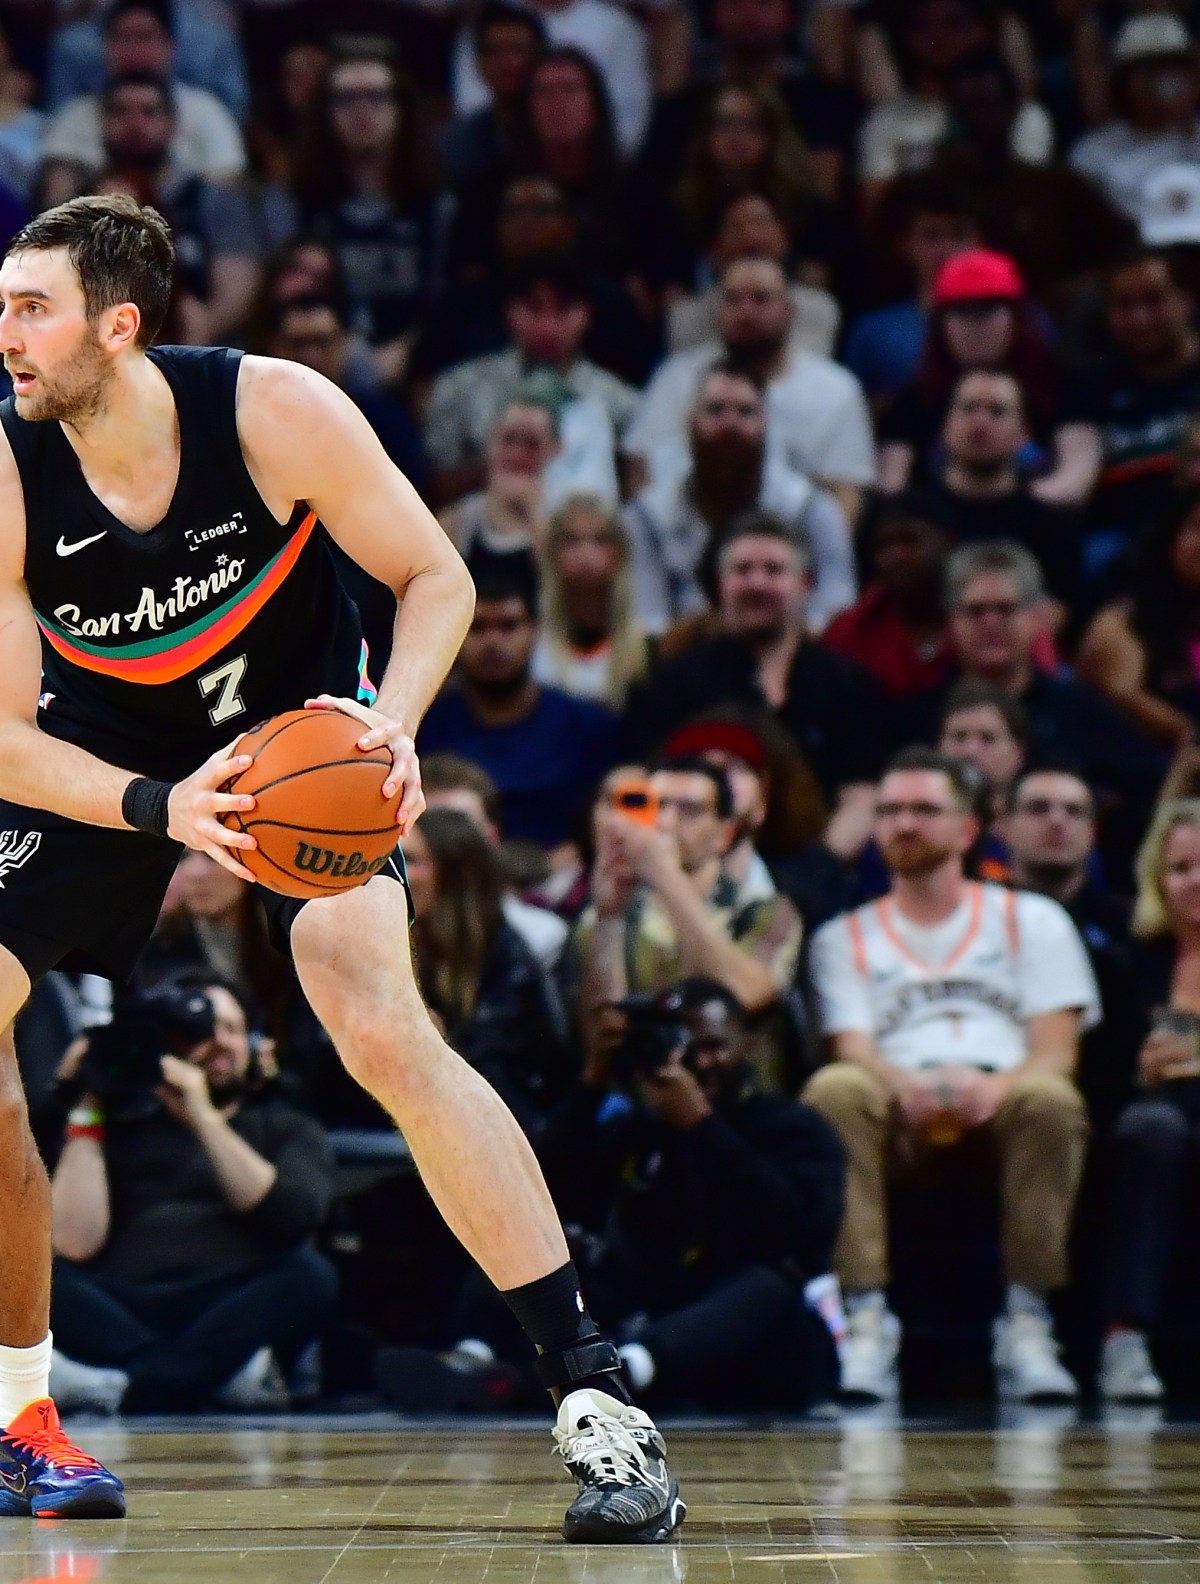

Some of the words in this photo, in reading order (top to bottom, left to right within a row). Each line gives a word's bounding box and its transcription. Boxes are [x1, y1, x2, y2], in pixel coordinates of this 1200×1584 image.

[193, 521, 238, 544] LEDGER
[53, 603, 120, 637] San
[124, 553, 246, 632] Antonio
[197, 653, 248, 727] 7
[294, 841, 392, 877] Wilso
